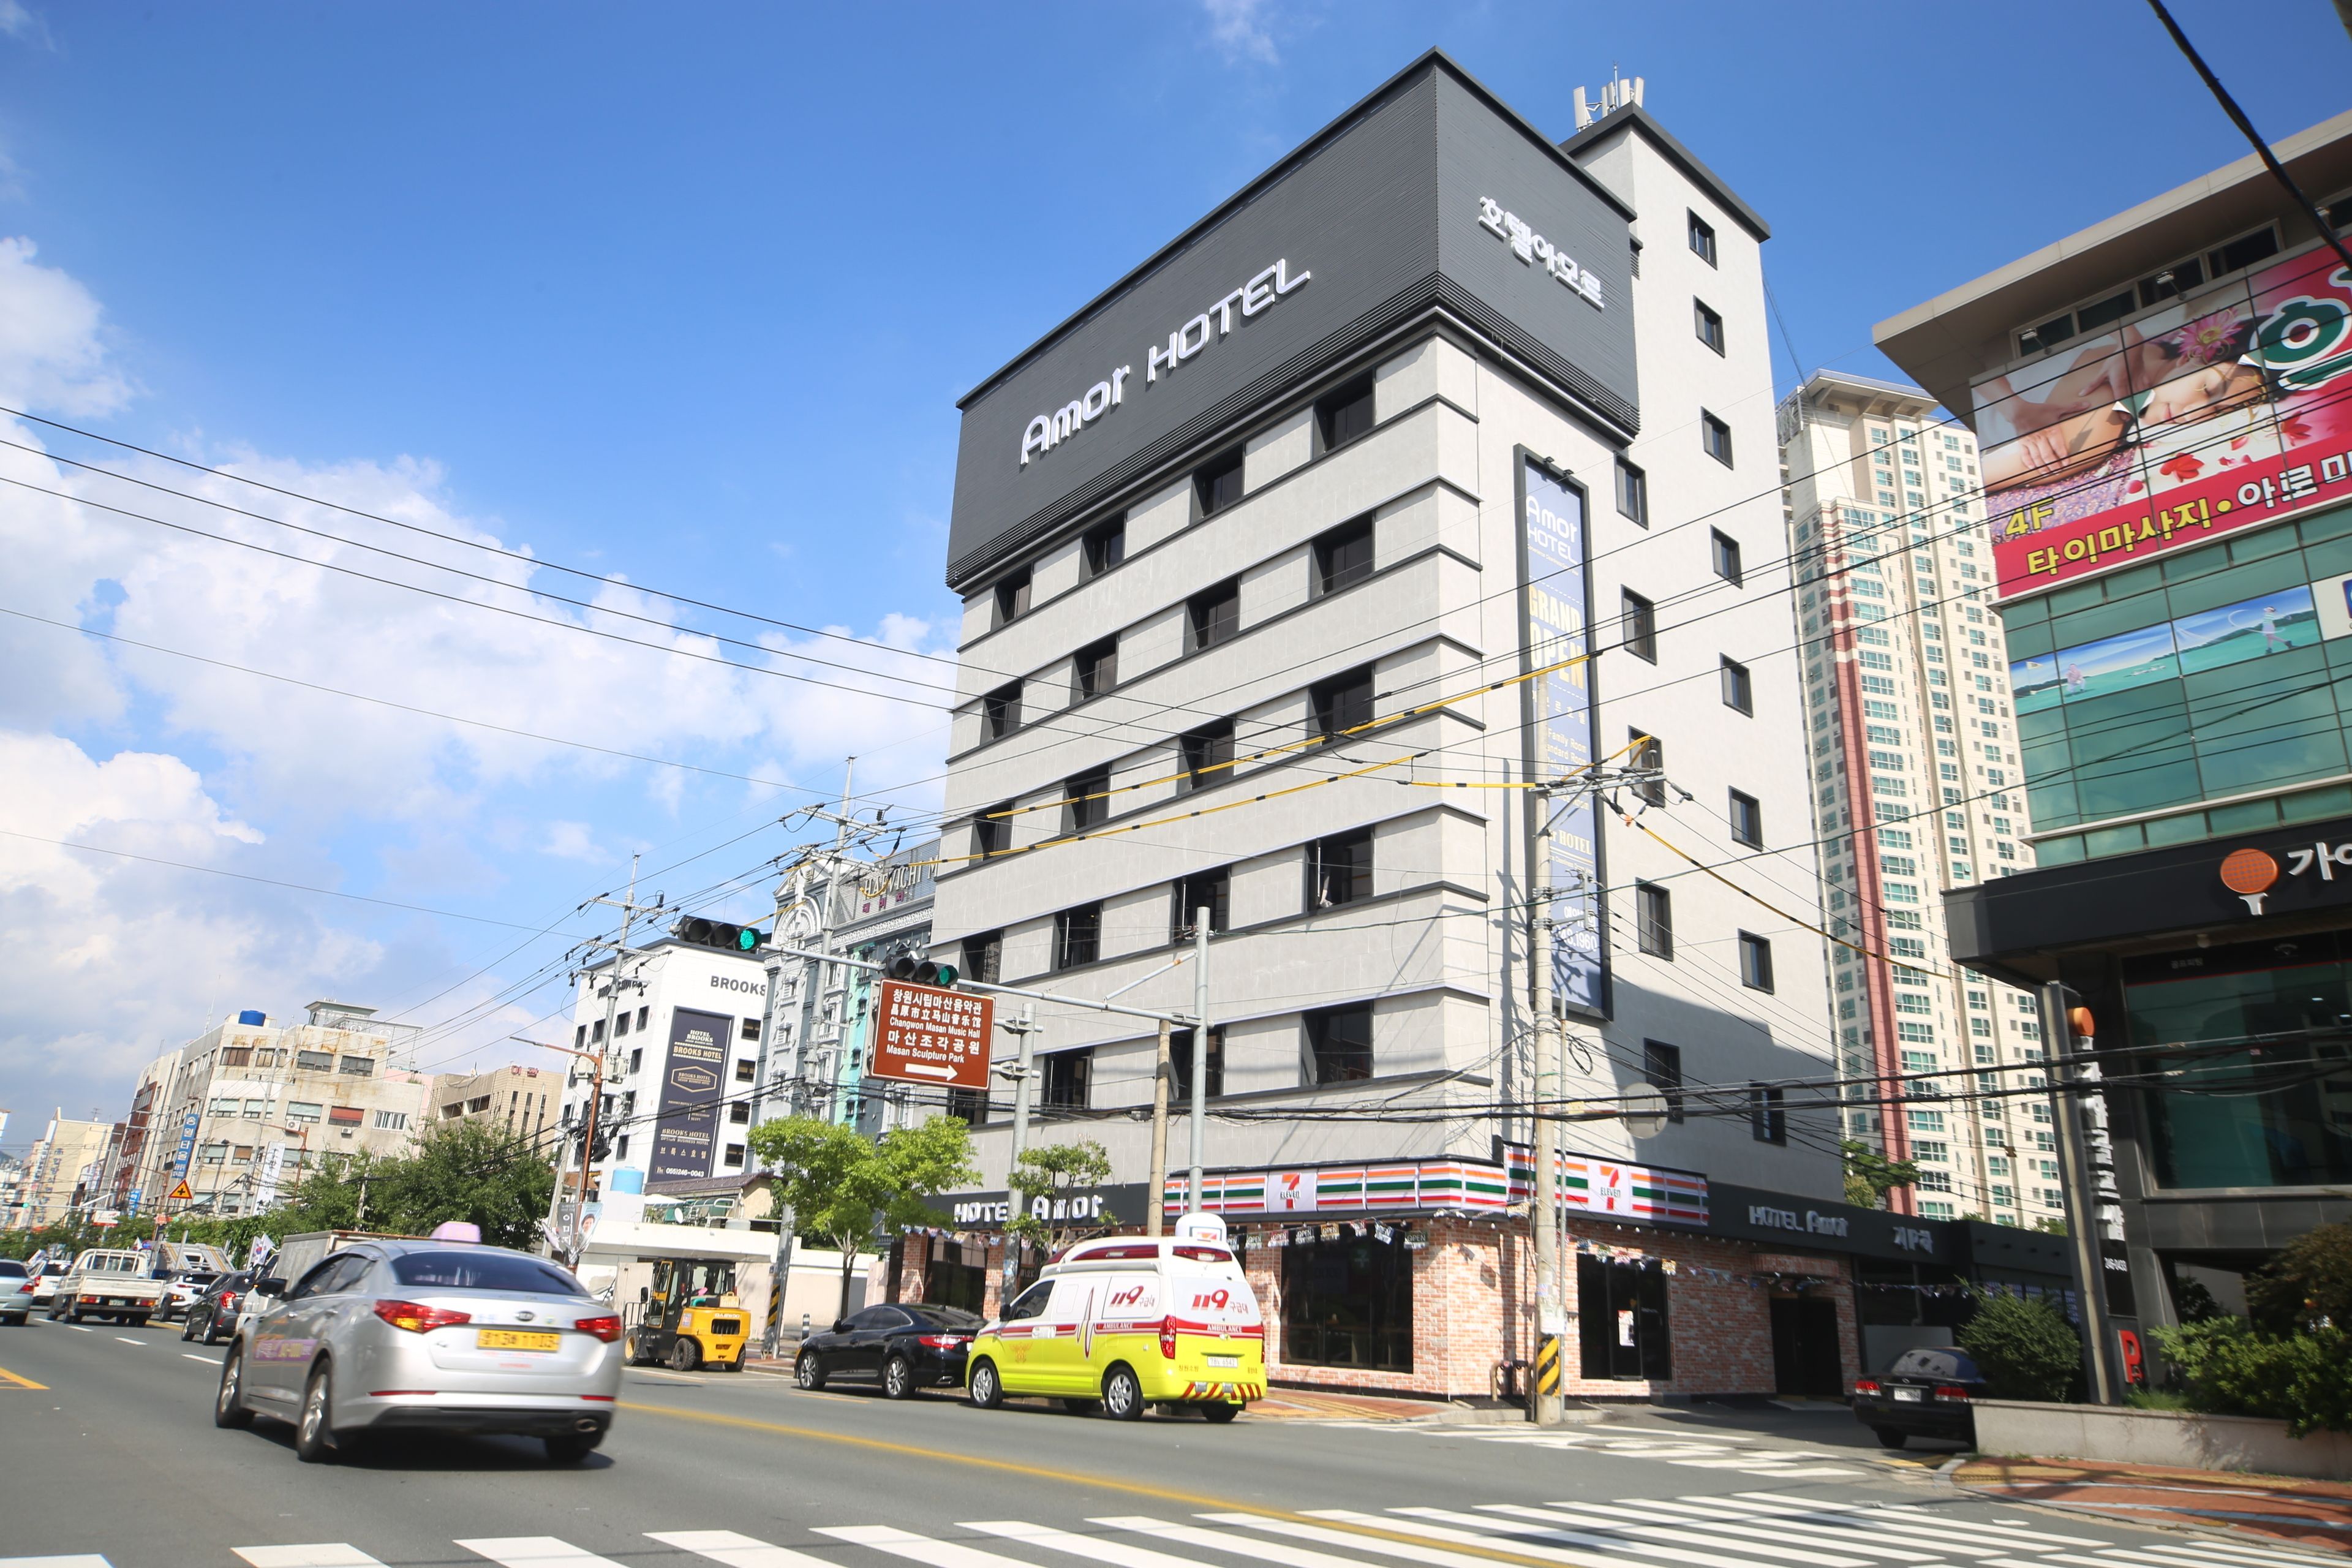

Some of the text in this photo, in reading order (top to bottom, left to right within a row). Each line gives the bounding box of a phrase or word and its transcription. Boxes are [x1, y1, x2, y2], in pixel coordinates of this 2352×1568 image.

[1478, 196, 1604, 309] 호텔아모르
[1020, 258, 1311, 466] Amor HOTEL
[1526, 495, 1578, 543] Amor
[2005, 497, 2054, 536] 4F
[1527, 524, 1578, 565] HOTEL
[1529, 584, 1582, 640] GRAND
[1530, 622, 1585, 690] OPEN
[1547, 744, 1569, 760] andard
[1559, 830, 1592, 855] HOTEL
[710, 975, 766, 997] BROOKS
[893, 989, 982, 1016] 창원시립마산음악관
[889, 1016, 981, 1038] Changwon Masan Music Hall
[891, 1003, 982, 1028] 昌原市立马山音乐馆
[687, 1034, 714, 1043] BROOKS
[674, 1046, 722, 1059] BROOKS HOTEL
[886, 1044, 965, 1063] Masan Sculpture Park
[954, 1201, 1009, 1223] HOTE
[1749, 1205, 1804, 1231] HOTEL
[1110, 1286, 1144, 1305] 119
[1192, 1289, 1249, 1314] 119 구급대
[2117, 1329, 2141, 1384] P
